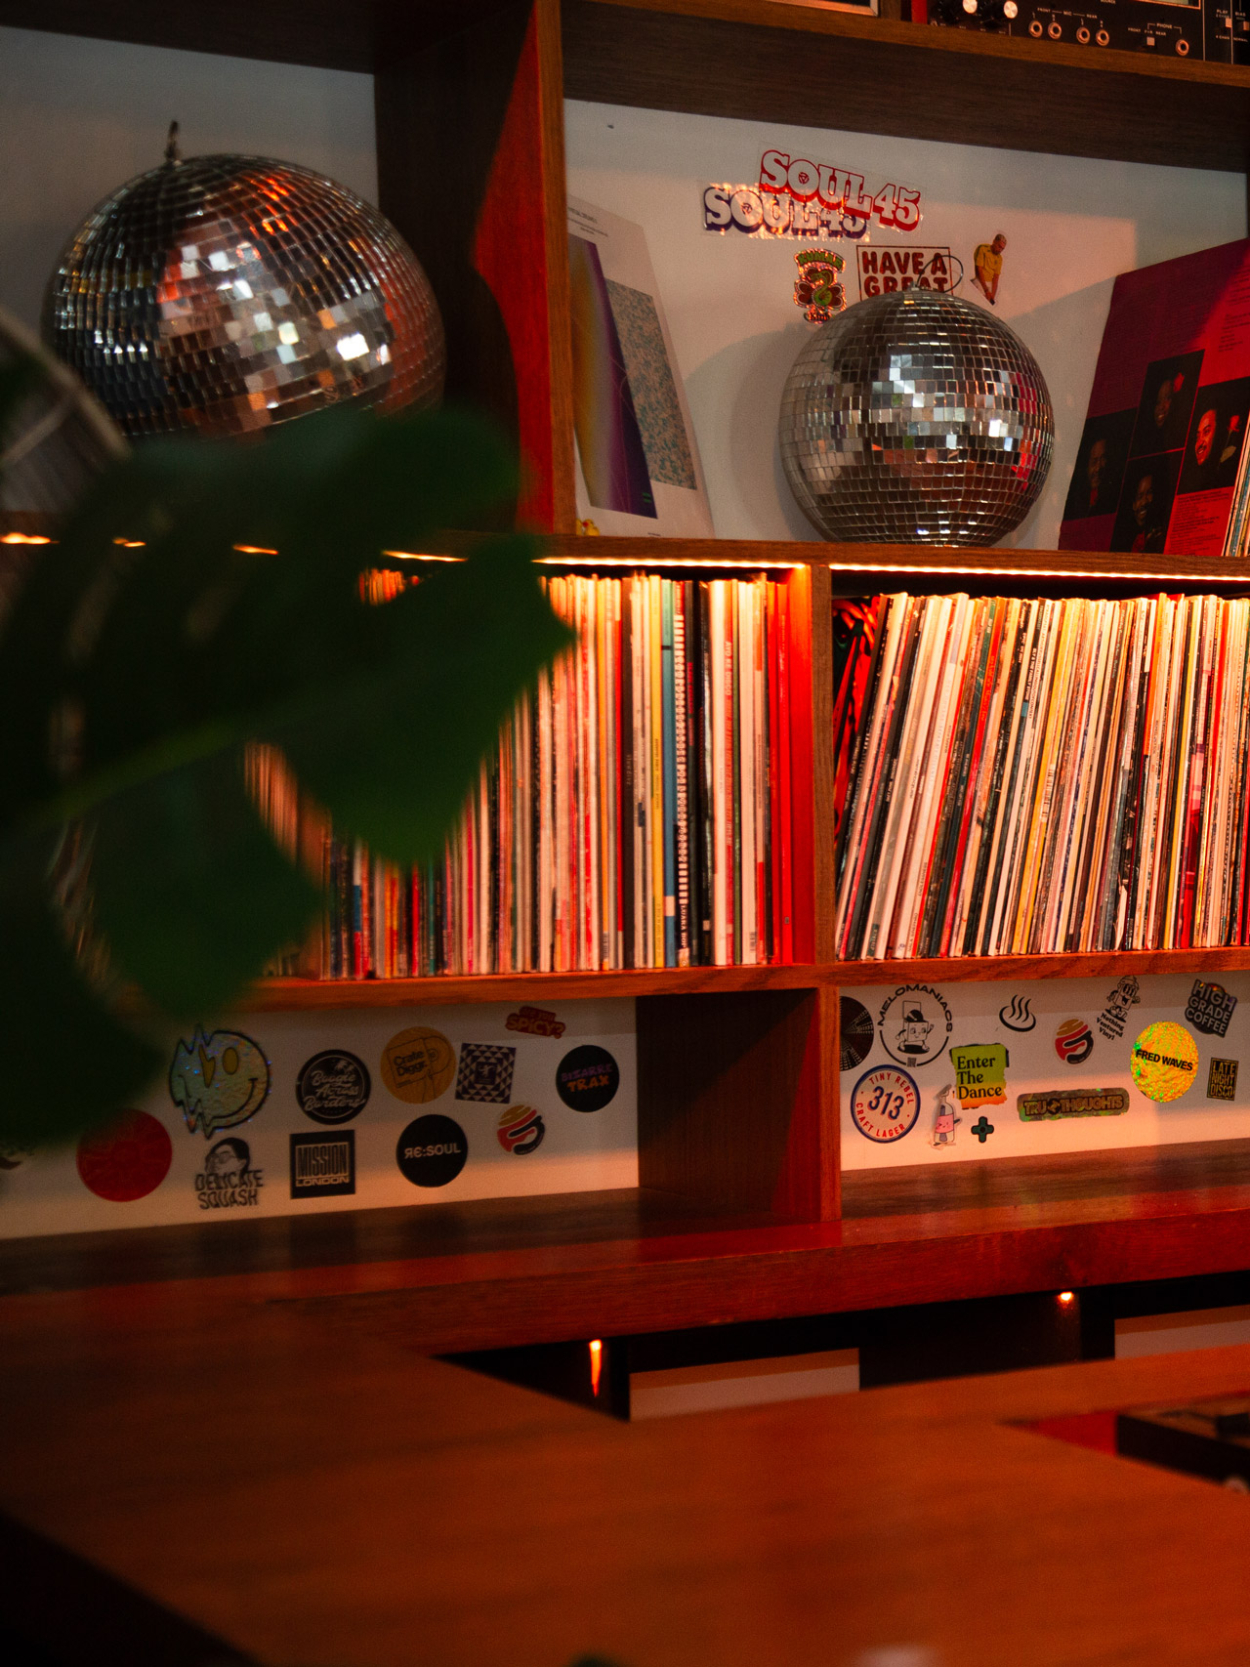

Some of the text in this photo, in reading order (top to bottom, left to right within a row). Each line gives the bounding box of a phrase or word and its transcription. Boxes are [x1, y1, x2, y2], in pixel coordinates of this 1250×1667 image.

[759, 149, 921, 232] SOUL 45
[703, 186, 820, 236] SOUL
[861, 250, 948, 275] HAVE A
[1192, 980, 1237, 1012] HIGH
[877, 983, 953, 1033] MELOMANIACS
[1189, 996, 1231, 1023] GRADE
[1186, 1007, 1227, 1035] COFFEE
[957, 1055, 996, 1070] Enter
[1135, 1049, 1193, 1072] FRED WAVES
[1213, 1061, 1236, 1075] LATE
[310, 1070, 357, 1087] Boogie
[566, 1074, 609, 1092] TRAX
[868, 1072, 915, 1105] TINY REBEL
[956, 1070, 984, 1085] The
[1211, 1073, 1235, 1086] NIGHT
[315, 1083, 360, 1098] Across
[958, 1085, 1003, 1101] Dance
[1210, 1084, 1235, 1097] DISCO
[303, 1095, 367, 1112] Borders
[867, 1085, 905, 1121] 313
[1023, 1094, 1125, 1116] TRU THOUGHTS
[856, 1102, 906, 1138] CRAFT LAGER
[297, 1144, 347, 1178] MISSION
[195, 1169, 263, 1191] DELICATE
[295, 1176, 350, 1188] LONDON
[197, 1189, 258, 1210] SQUASH
